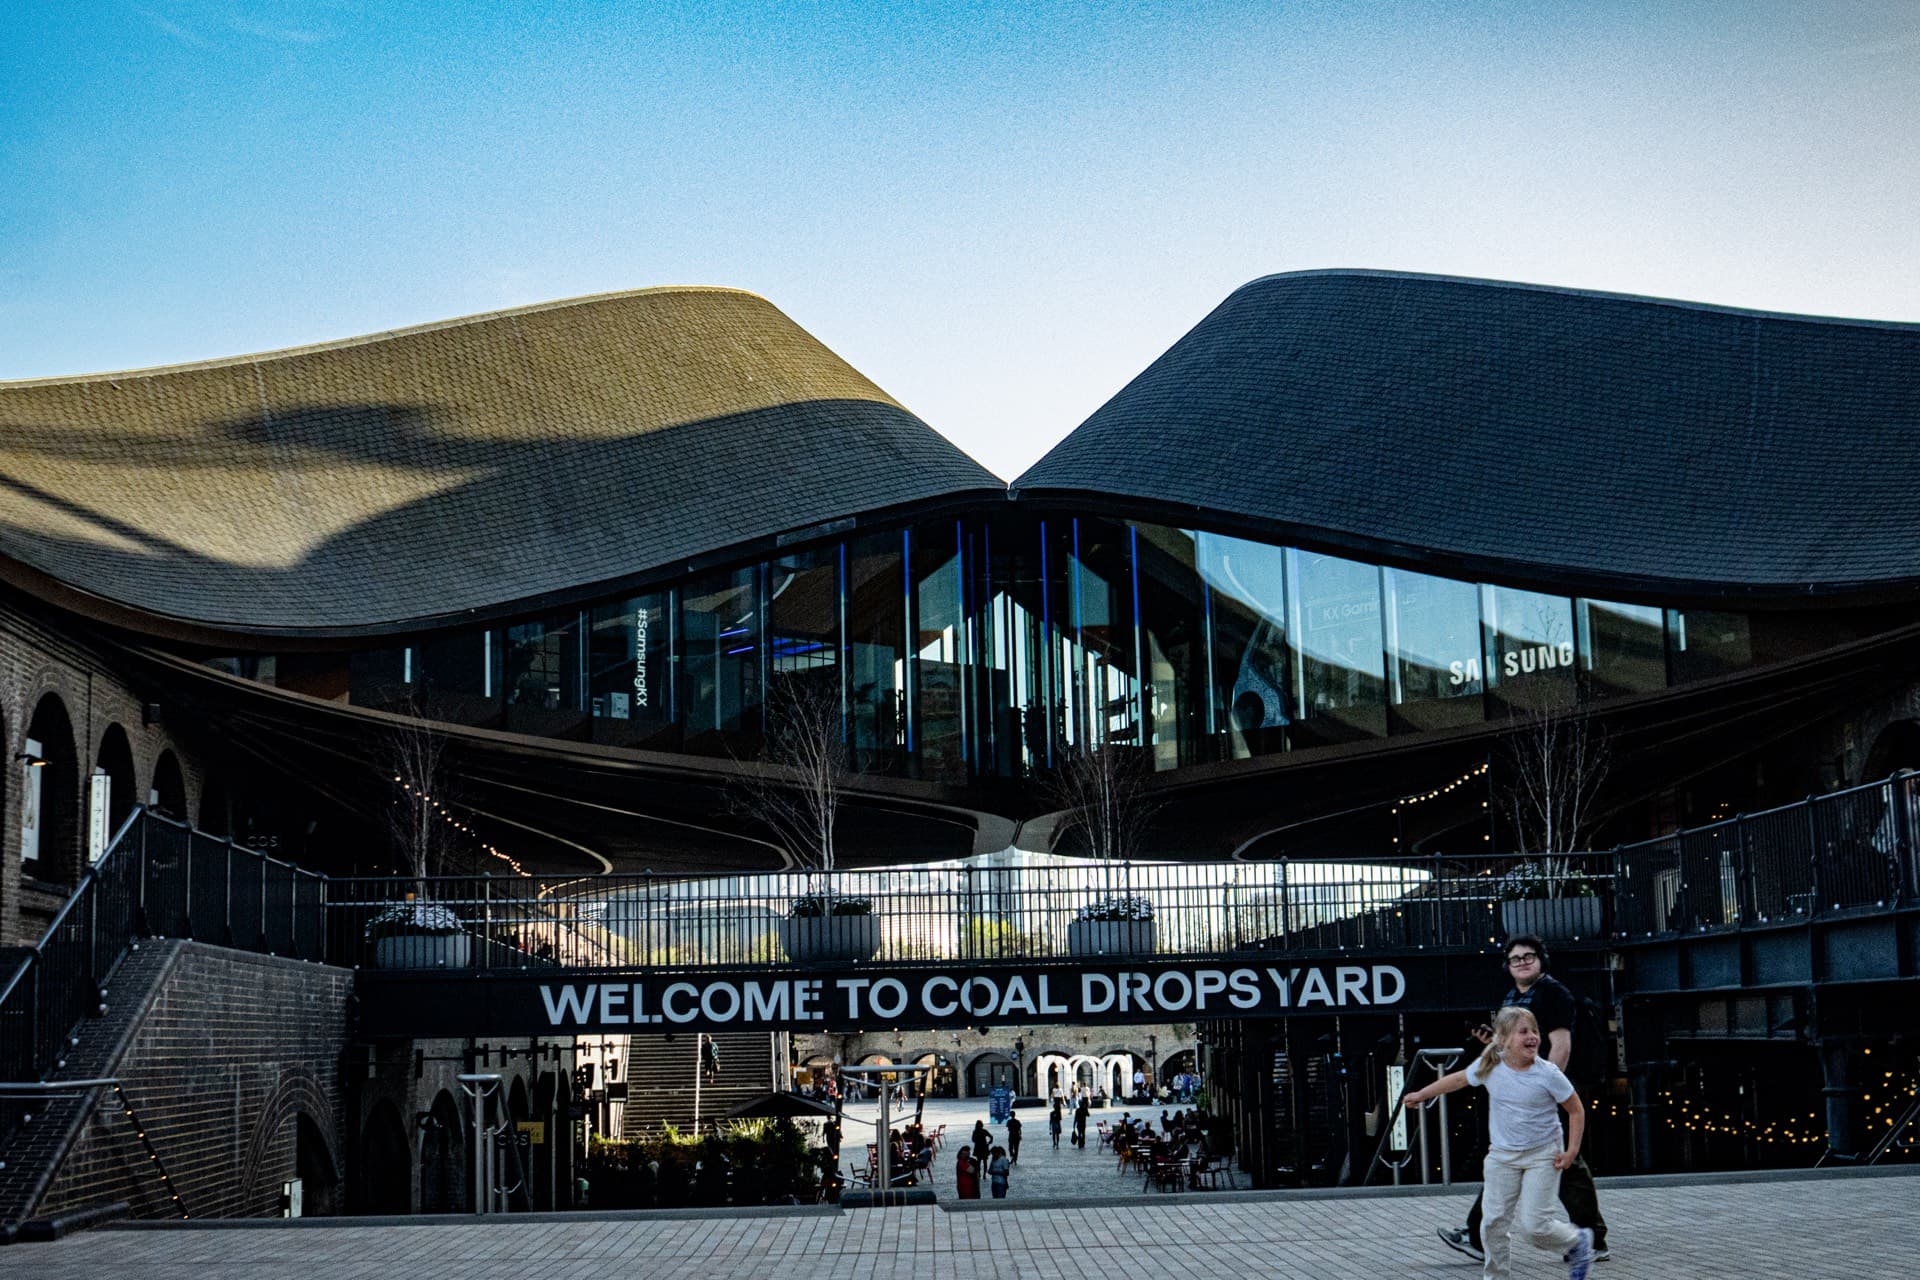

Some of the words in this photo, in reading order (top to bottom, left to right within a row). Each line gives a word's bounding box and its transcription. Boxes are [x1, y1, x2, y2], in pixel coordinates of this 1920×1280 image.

[633, 608, 648, 707] #SamsungKX
[539, 980, 824, 1025] WELCOME
[836, 978, 908, 1019] TO
[921, 975, 1068, 1017] COAL
[1081, 968, 1261, 1013] DROPS
[1266, 965, 1406, 1007] YARD
